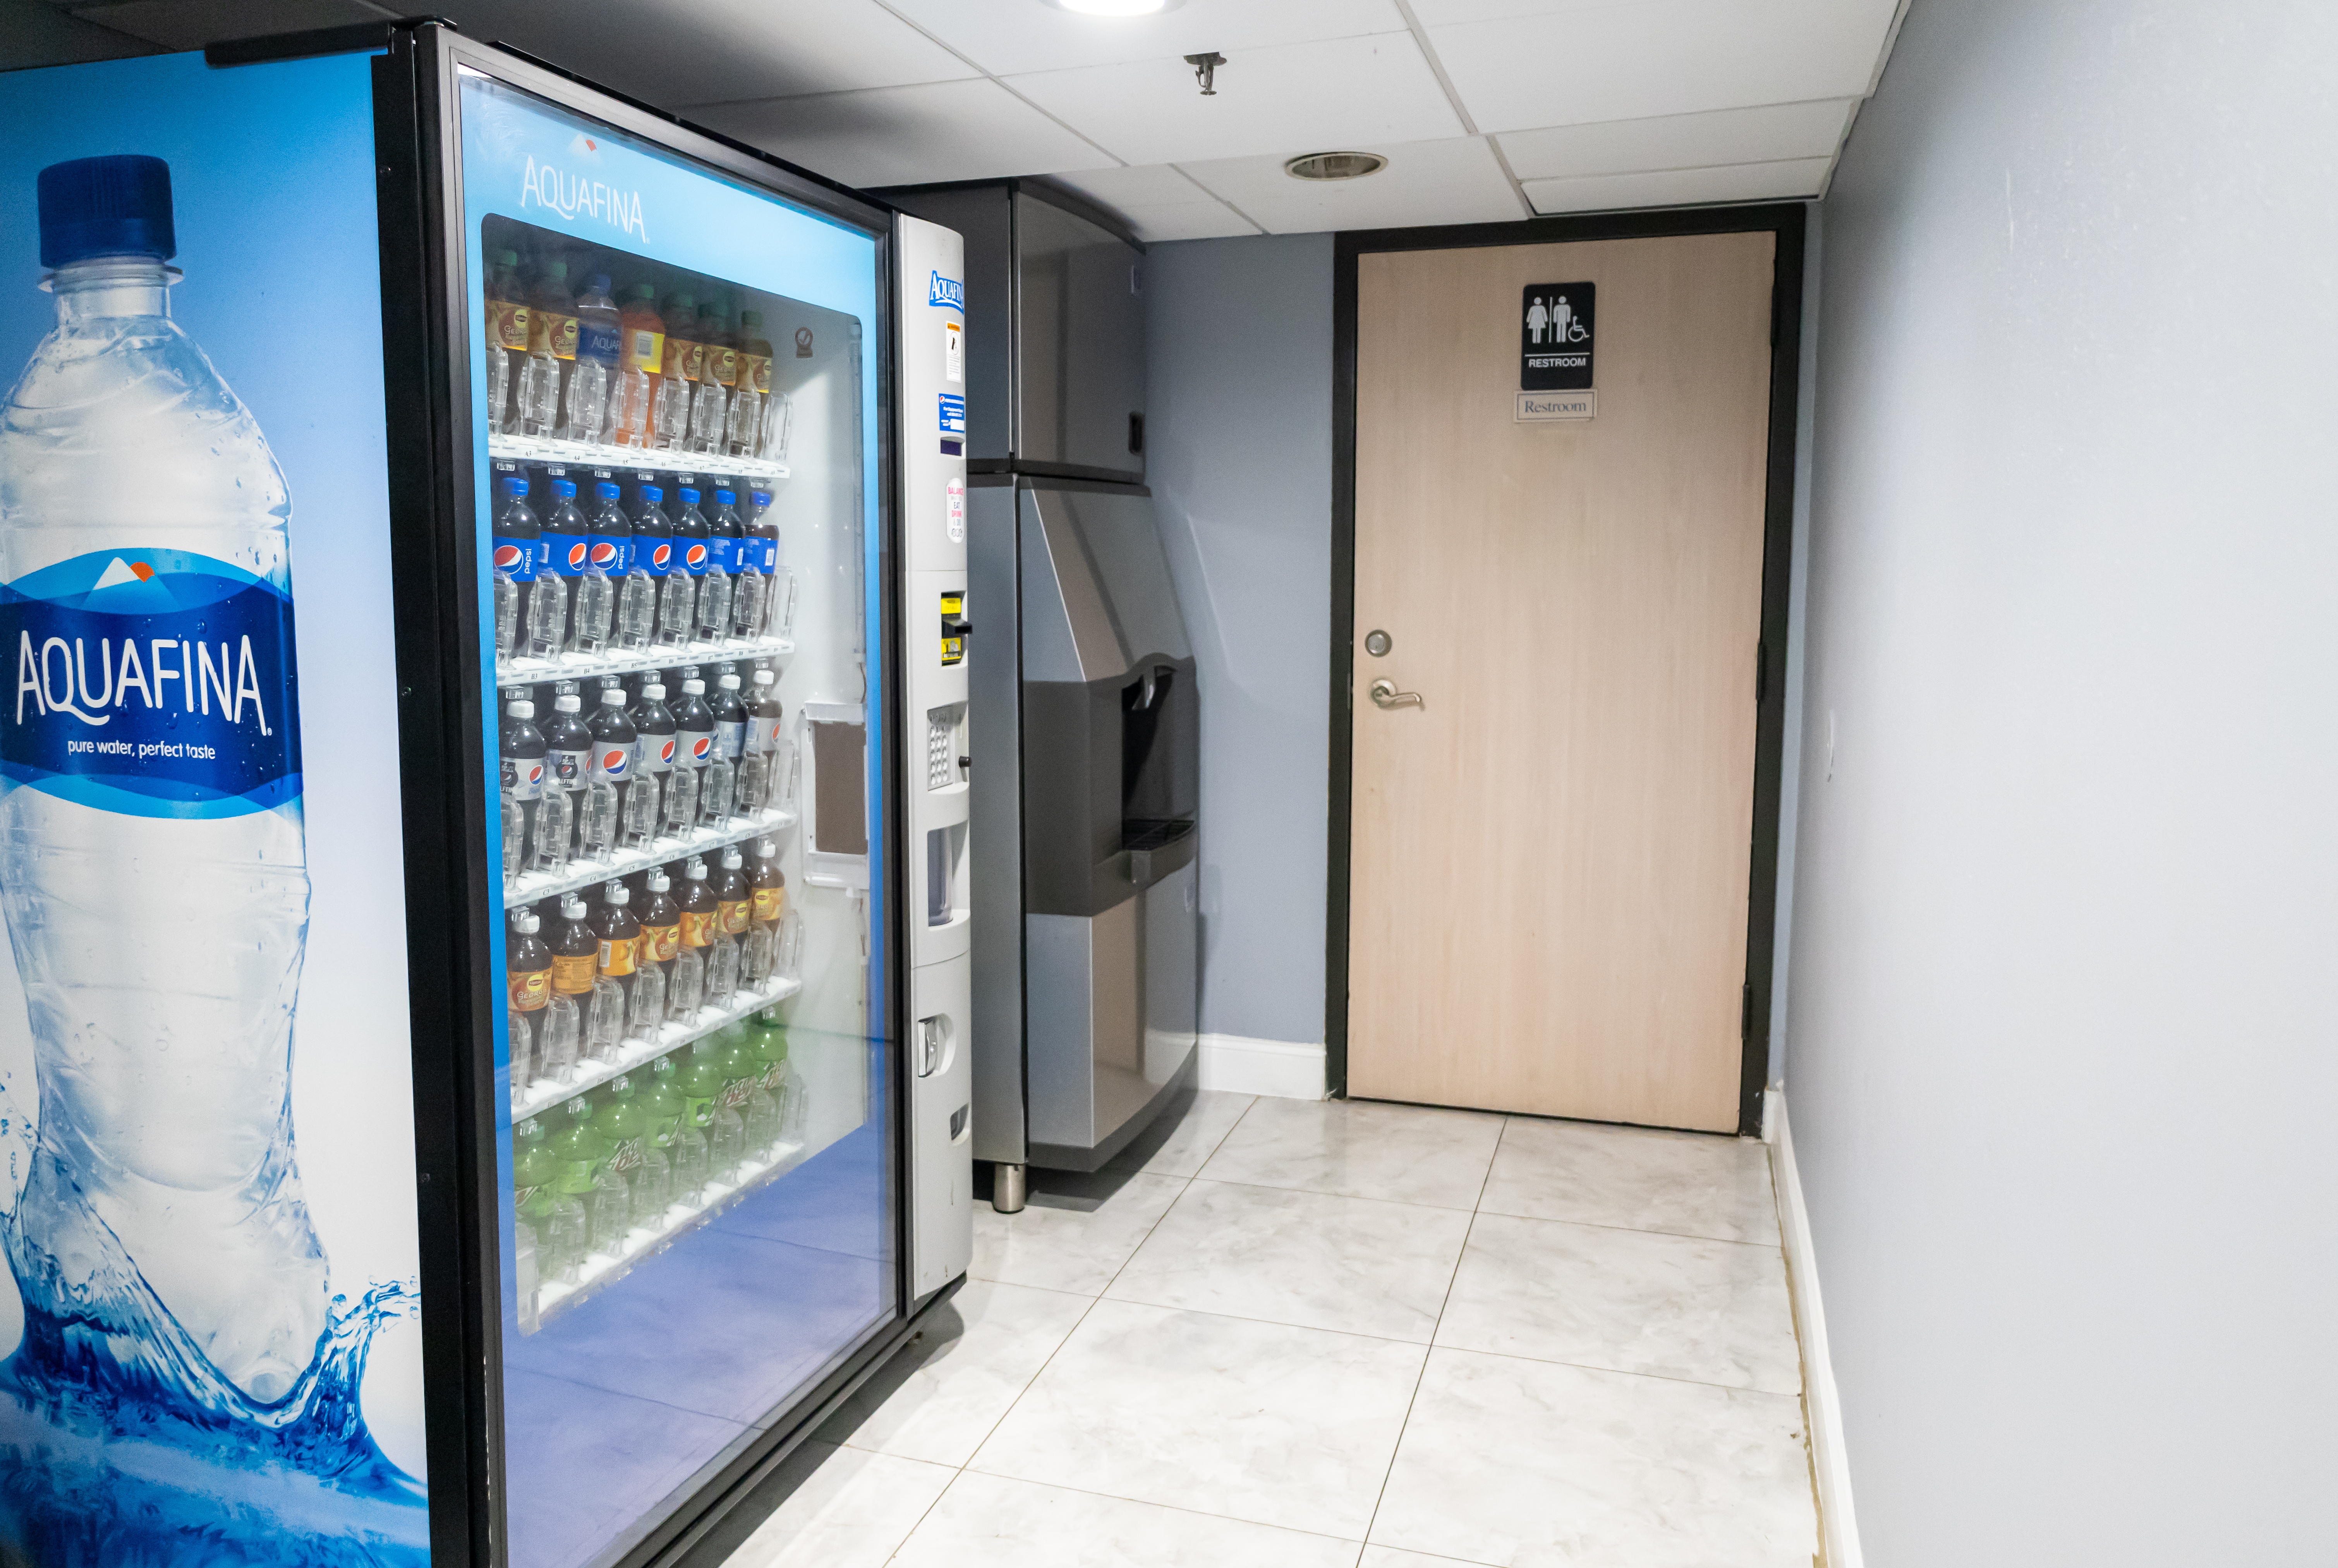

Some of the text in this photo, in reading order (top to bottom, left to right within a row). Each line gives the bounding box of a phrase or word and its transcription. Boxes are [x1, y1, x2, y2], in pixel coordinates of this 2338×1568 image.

[521, 154, 647, 244] AQUAFINA
[1529, 358, 1586, 368] RESTROOM
[1525, 400, 1586, 413] Restroom
[17, 630, 267, 736] AQUAFINA
[68, 740, 216, 759] pure water, perfect taste
